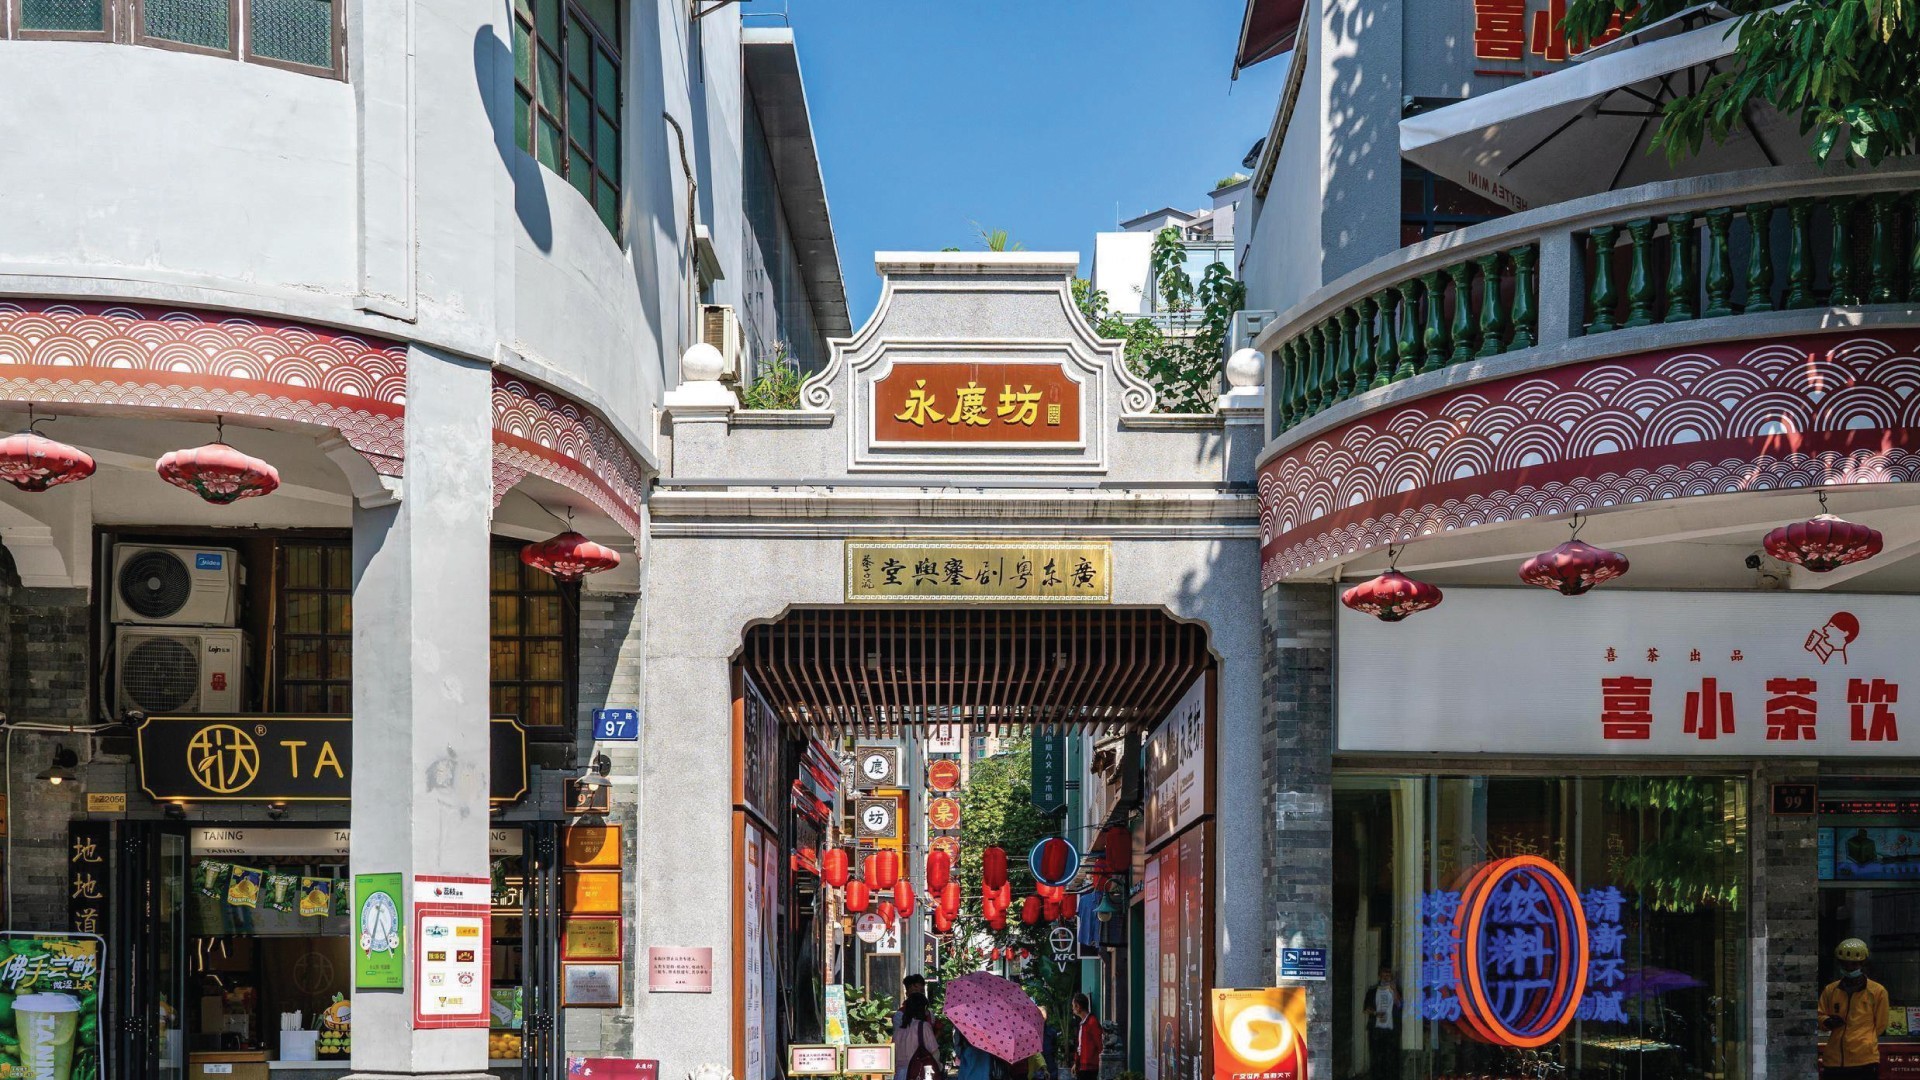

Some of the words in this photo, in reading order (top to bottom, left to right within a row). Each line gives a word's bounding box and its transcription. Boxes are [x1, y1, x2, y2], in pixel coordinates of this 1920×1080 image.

[894, 379, 1042, 426] 永慶坊
[1604, 647, 1744, 662] 喜茶出品
[1601, 676, 1899, 741] 喜小茶饮
[605, 720, 626, 737] 97
[1784, 796, 1802, 809] 99
[203, 831, 243, 841] TANING
[1054, 953, 1076, 961] KFC
[1502, 877, 1554, 1024] 饮料厂
